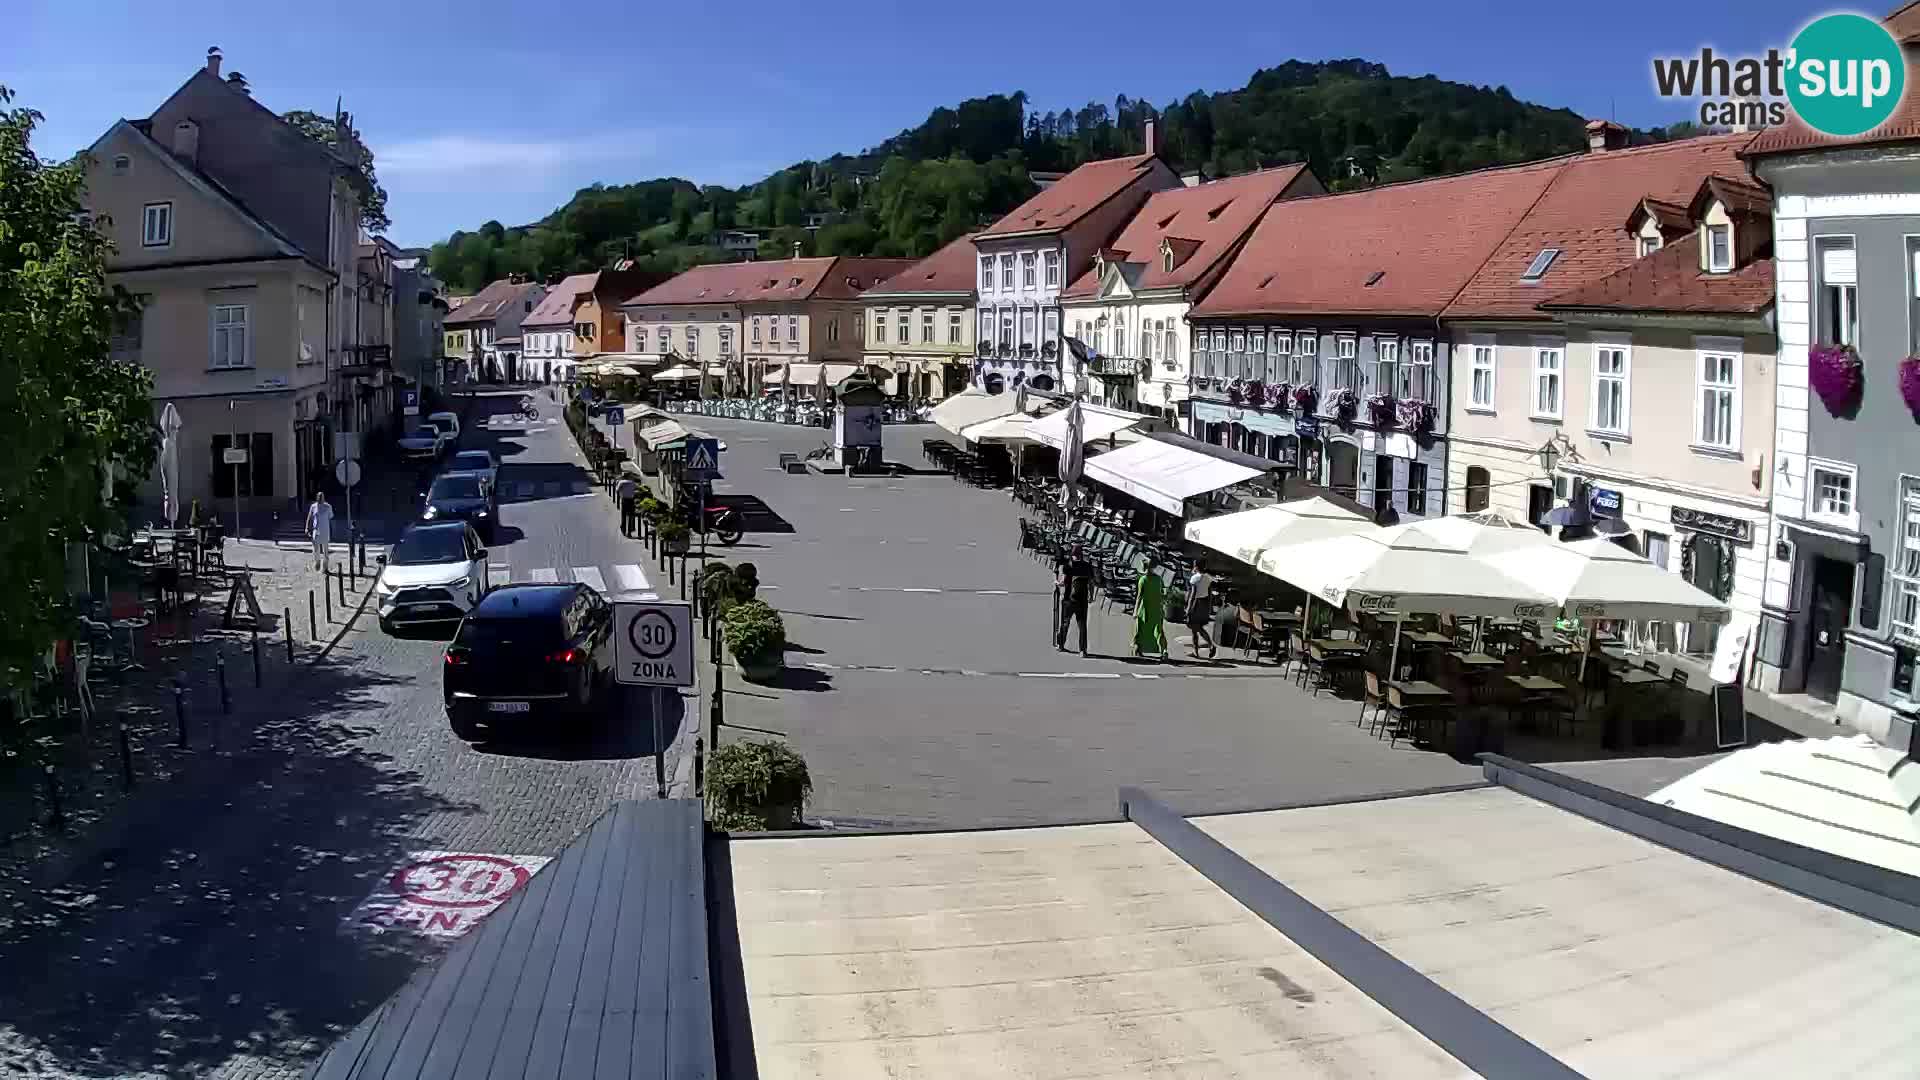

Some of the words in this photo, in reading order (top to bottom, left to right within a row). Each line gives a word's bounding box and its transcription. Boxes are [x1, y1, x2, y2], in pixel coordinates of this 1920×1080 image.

[407, 393, 415, 404] P
[642, 624, 666, 645] 30
[632, 662, 676, 679] ZONA
[403, 864, 503, 894] 30
